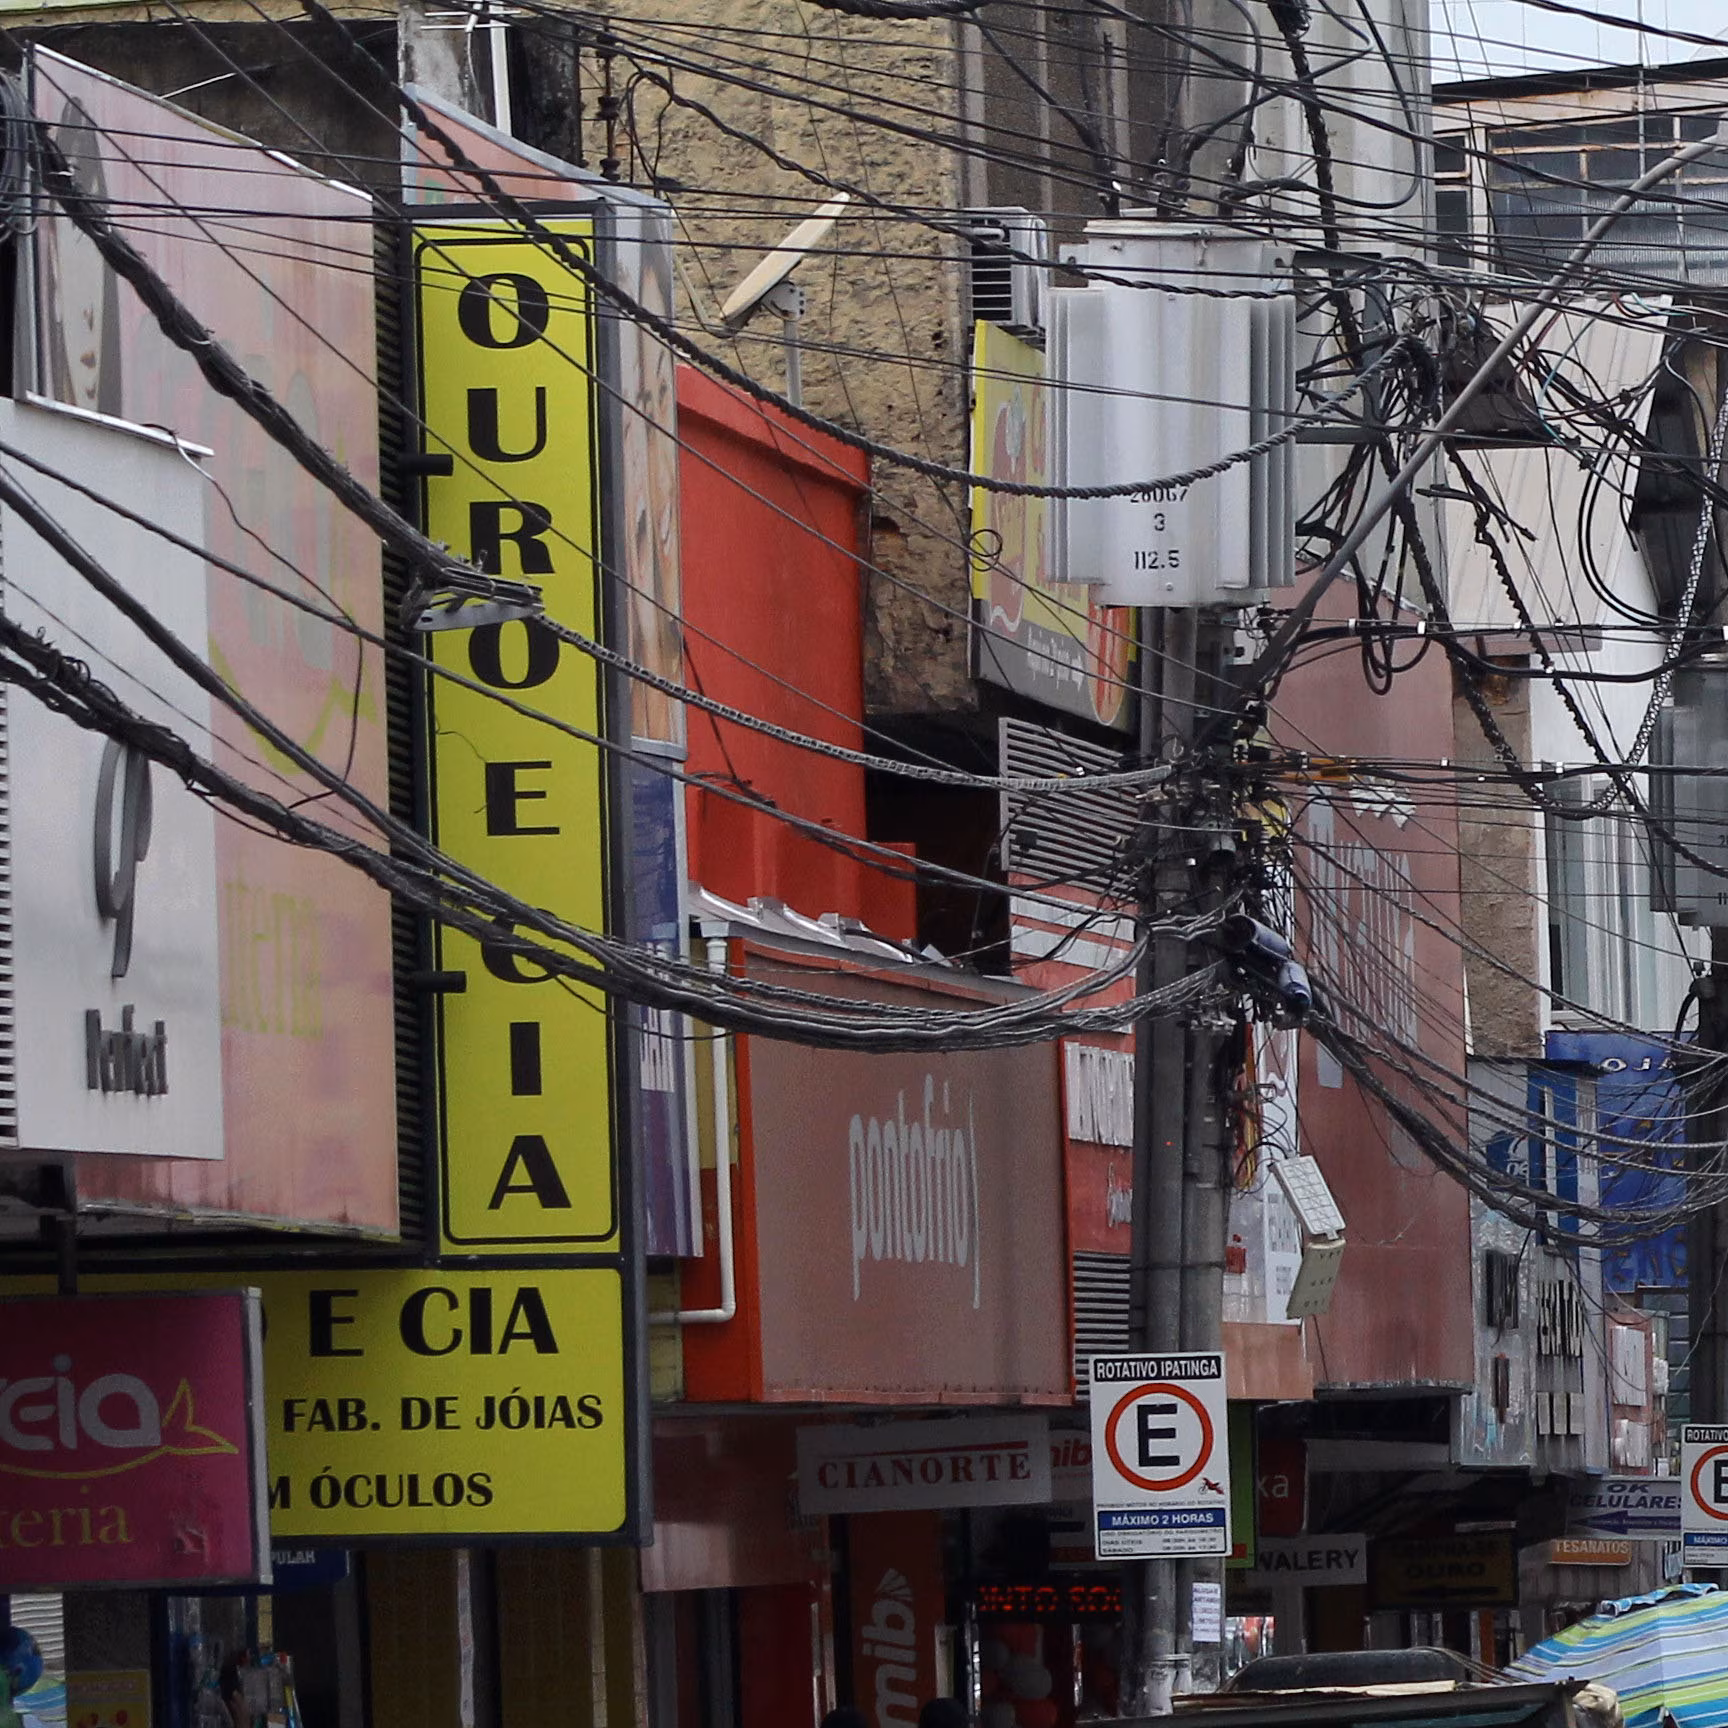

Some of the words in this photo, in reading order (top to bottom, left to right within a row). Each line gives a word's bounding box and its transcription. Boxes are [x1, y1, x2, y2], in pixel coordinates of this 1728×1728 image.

[456, 272, 562, 690] OURO
[1154, 513, 1166, 532] 3
[1134, 550, 1180, 570] 112.5
[485, 760, 560, 837] E
[308, 1289, 364, 1357] E
[399, 1286, 559, 1357] CIA
[1096, 1360, 1157, 1379] ROTATIVO
[1161, 1358, 1219, 1378] IPATINGA
[282, 1397, 381, 1432] FAB.
[401, 1396, 461, 1431] DE
[474, 1386, 603, 1430] JÓIAS
[1137, 1403, 1180, 1467] E
[310, 1465, 494, 1508] ÓCULOS
[817, 1452, 1031, 1489] CIANORTE
[1608, 1483, 1649, 1494] OK
[1112, 1511, 1158, 1527] MÁXIMO
[1162, 1514, 1170, 1526] 2
[1172, 1512, 1214, 1525] HORAS
